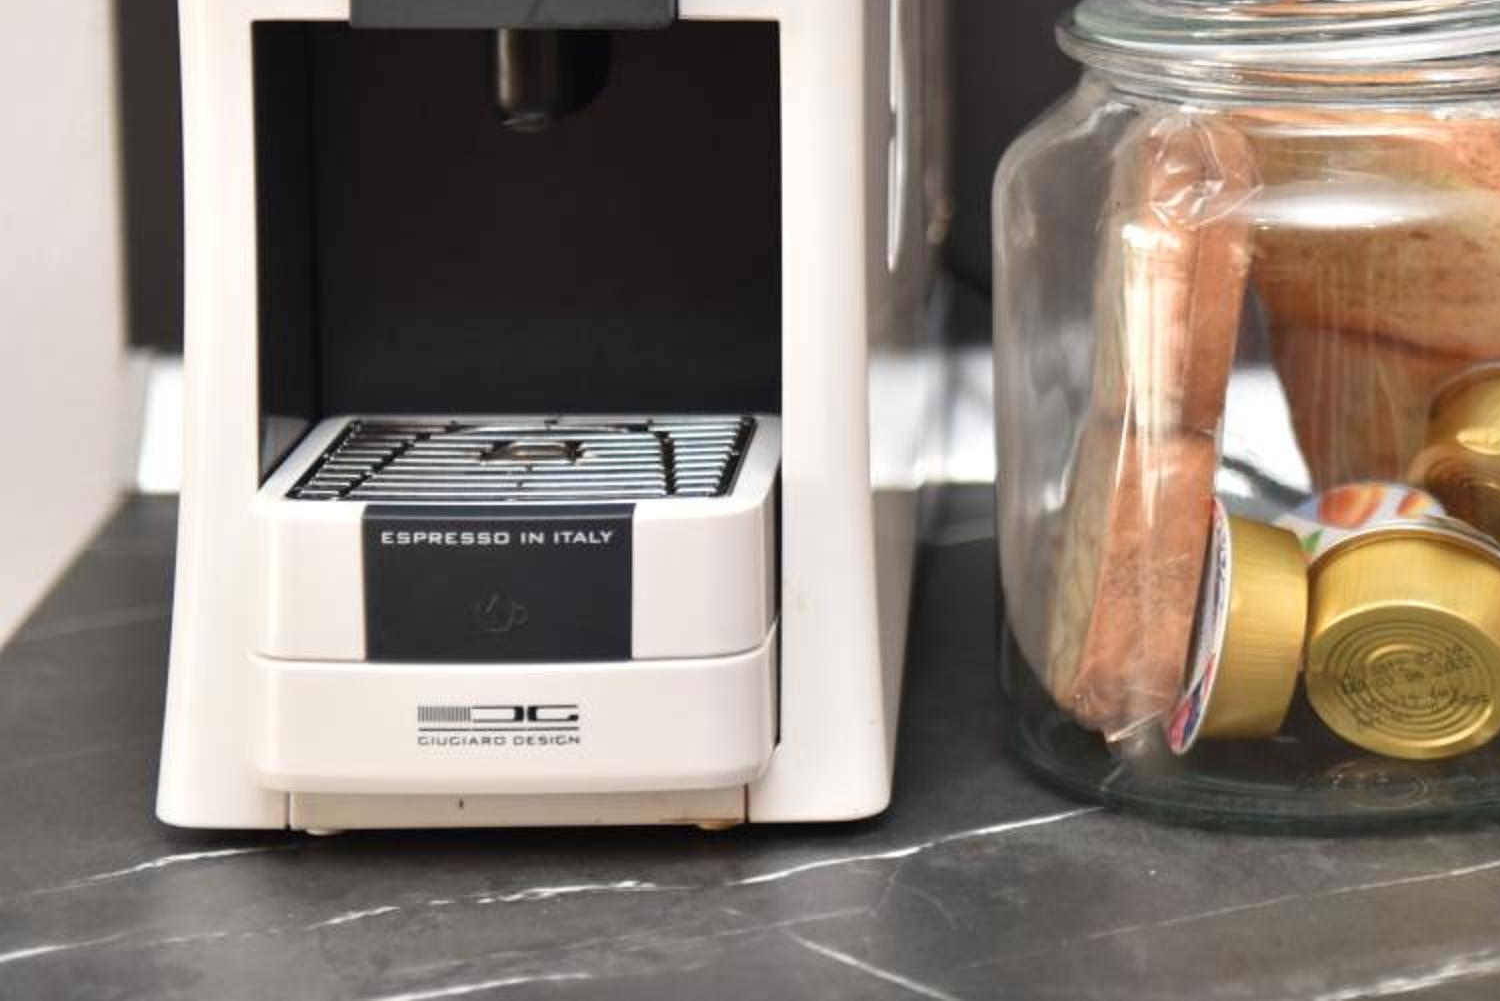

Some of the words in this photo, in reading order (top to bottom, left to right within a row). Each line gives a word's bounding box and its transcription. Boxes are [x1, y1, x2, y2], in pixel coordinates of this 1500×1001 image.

[381, 531, 511, 545] ESPRESSO
[520, 531, 545, 545] IN
[554, 530, 613, 544] ITALY
[417, 735, 506, 746] GIUGIARO
[513, 734, 580, 745] DESIGN
